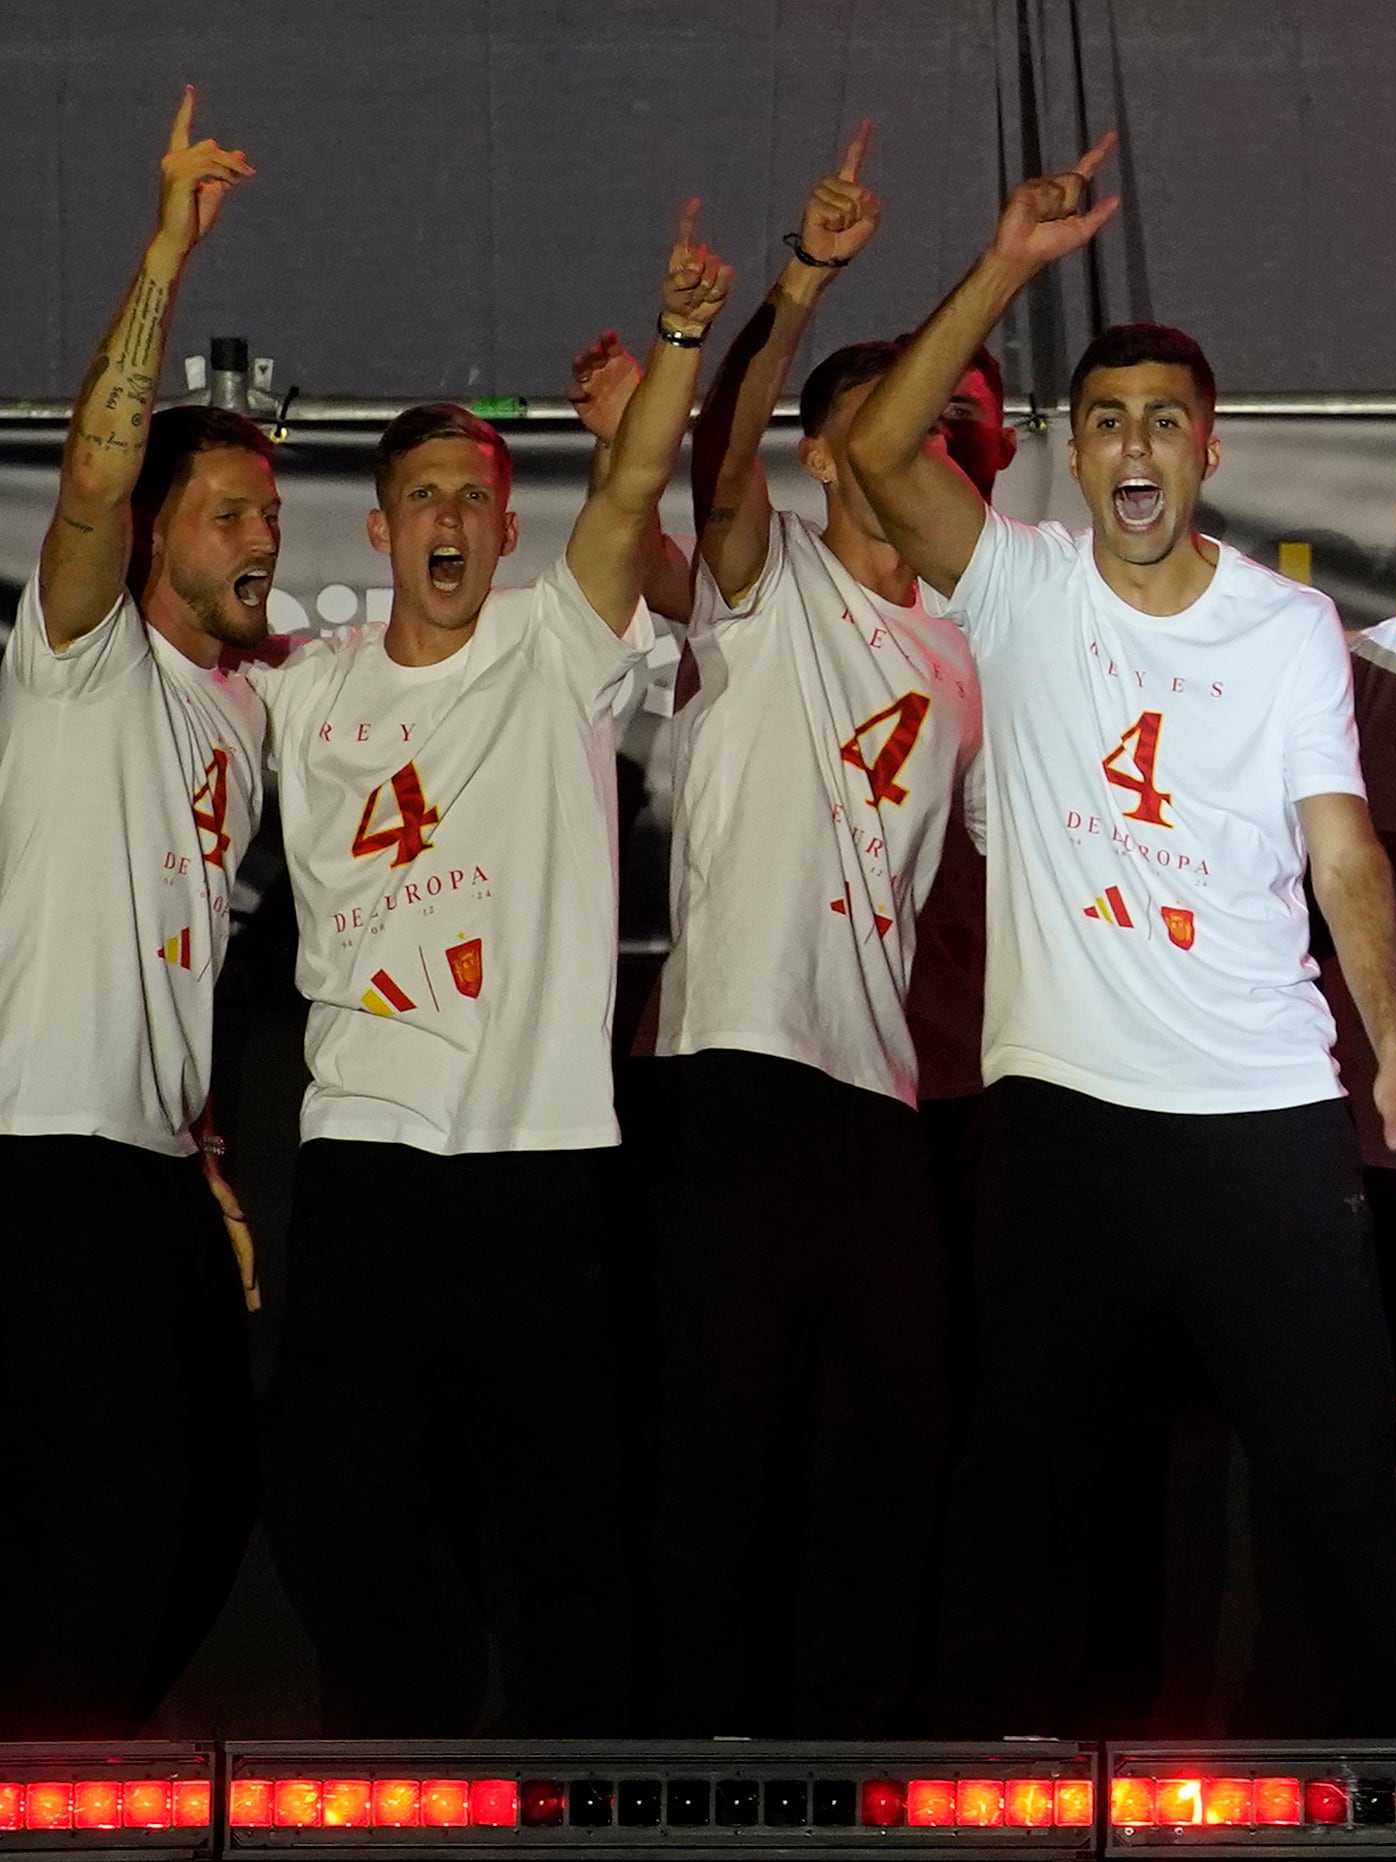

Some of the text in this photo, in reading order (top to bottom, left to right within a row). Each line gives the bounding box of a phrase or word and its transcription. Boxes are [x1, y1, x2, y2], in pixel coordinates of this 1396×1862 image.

[319, 723, 416, 742] REY
[839, 689, 931, 808] 4
[1101, 711, 1174, 829] 4
[190, 748, 231, 870] 4
[351, 760, 440, 870] 4
[1066, 811, 1101, 835] DE
[163, 850, 191, 877] DE
[333, 866, 489, 933] DE UROPA
